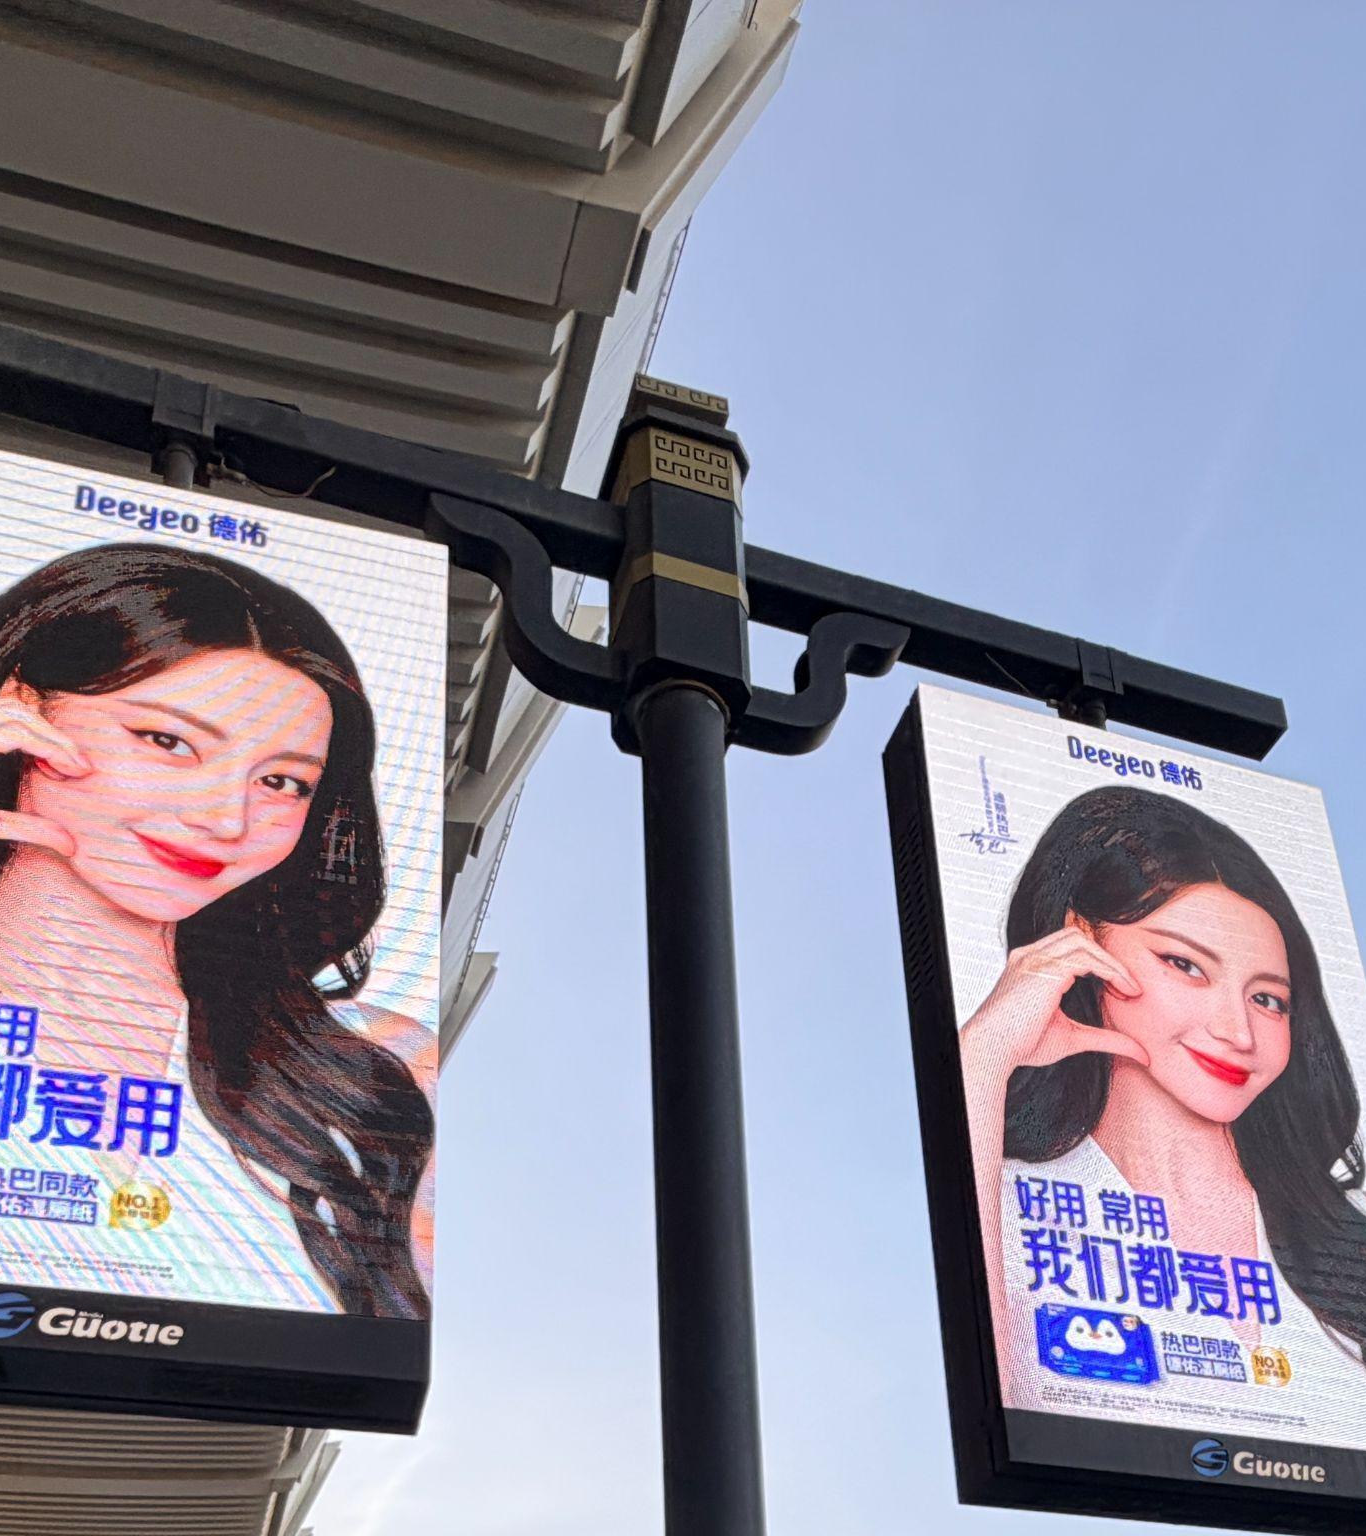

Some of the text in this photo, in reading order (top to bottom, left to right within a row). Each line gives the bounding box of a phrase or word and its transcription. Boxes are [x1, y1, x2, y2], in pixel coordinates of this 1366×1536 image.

[74, 484, 269, 548] Deeyeo 德佑
[1067, 735, 1203, 791] Deeyeo 德佑
[117, 1193, 160, 1211] NO.1
[1014, 1174, 1170, 1241] 好用 常用
[1020, 1227, 1282, 1326] 我们都爱用
[38, 1306, 185, 1346] Guotie
[1160, 1330, 1243, 1361] 热巴同款
[1254, 1354, 1285, 1370] NO.1
[1232, 1450, 1327, 1483] Guotie
